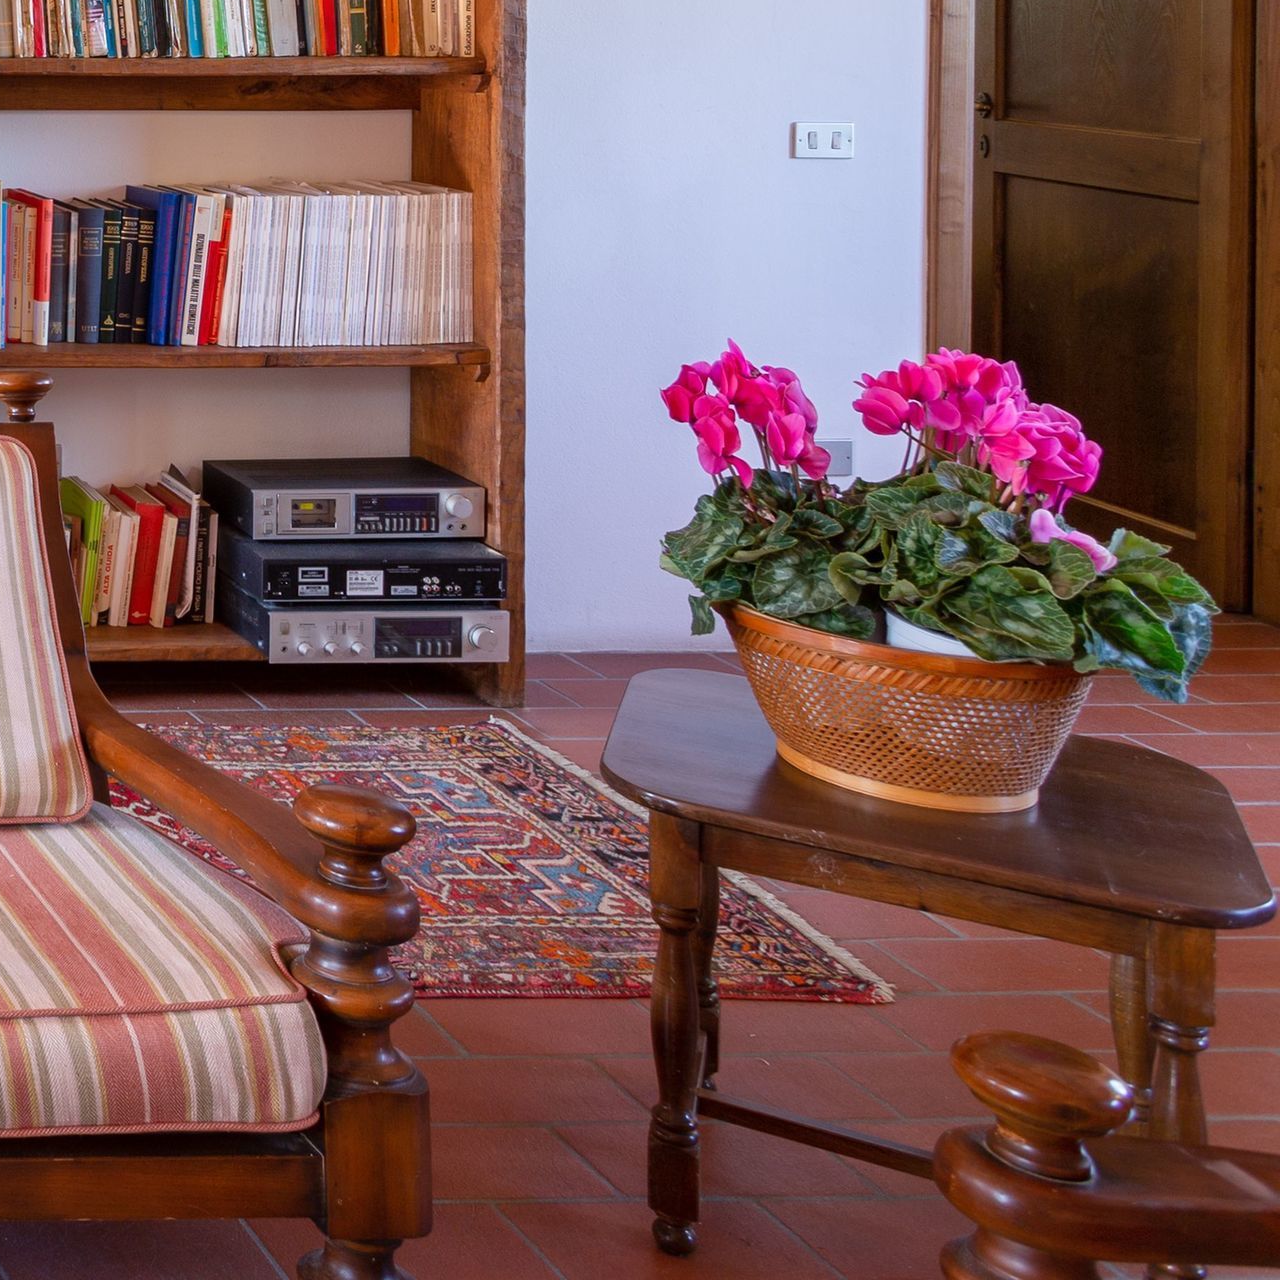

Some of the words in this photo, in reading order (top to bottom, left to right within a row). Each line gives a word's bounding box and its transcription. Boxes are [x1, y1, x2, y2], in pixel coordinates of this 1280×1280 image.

[464, 15, 472, 56] Educazione
[124, 242, 133, 274] ORTOPEDIA
[194, 233, 206, 264] DIZIONARIO
[139, 246, 149, 283] ORTOPEDIA
[192, 263, 201, 278] DELLE
[189, 278, 200, 303] MALATTIE
[186, 303, 199, 335] REUMATICHE
[105, 544, 114, 572] GUIDA
